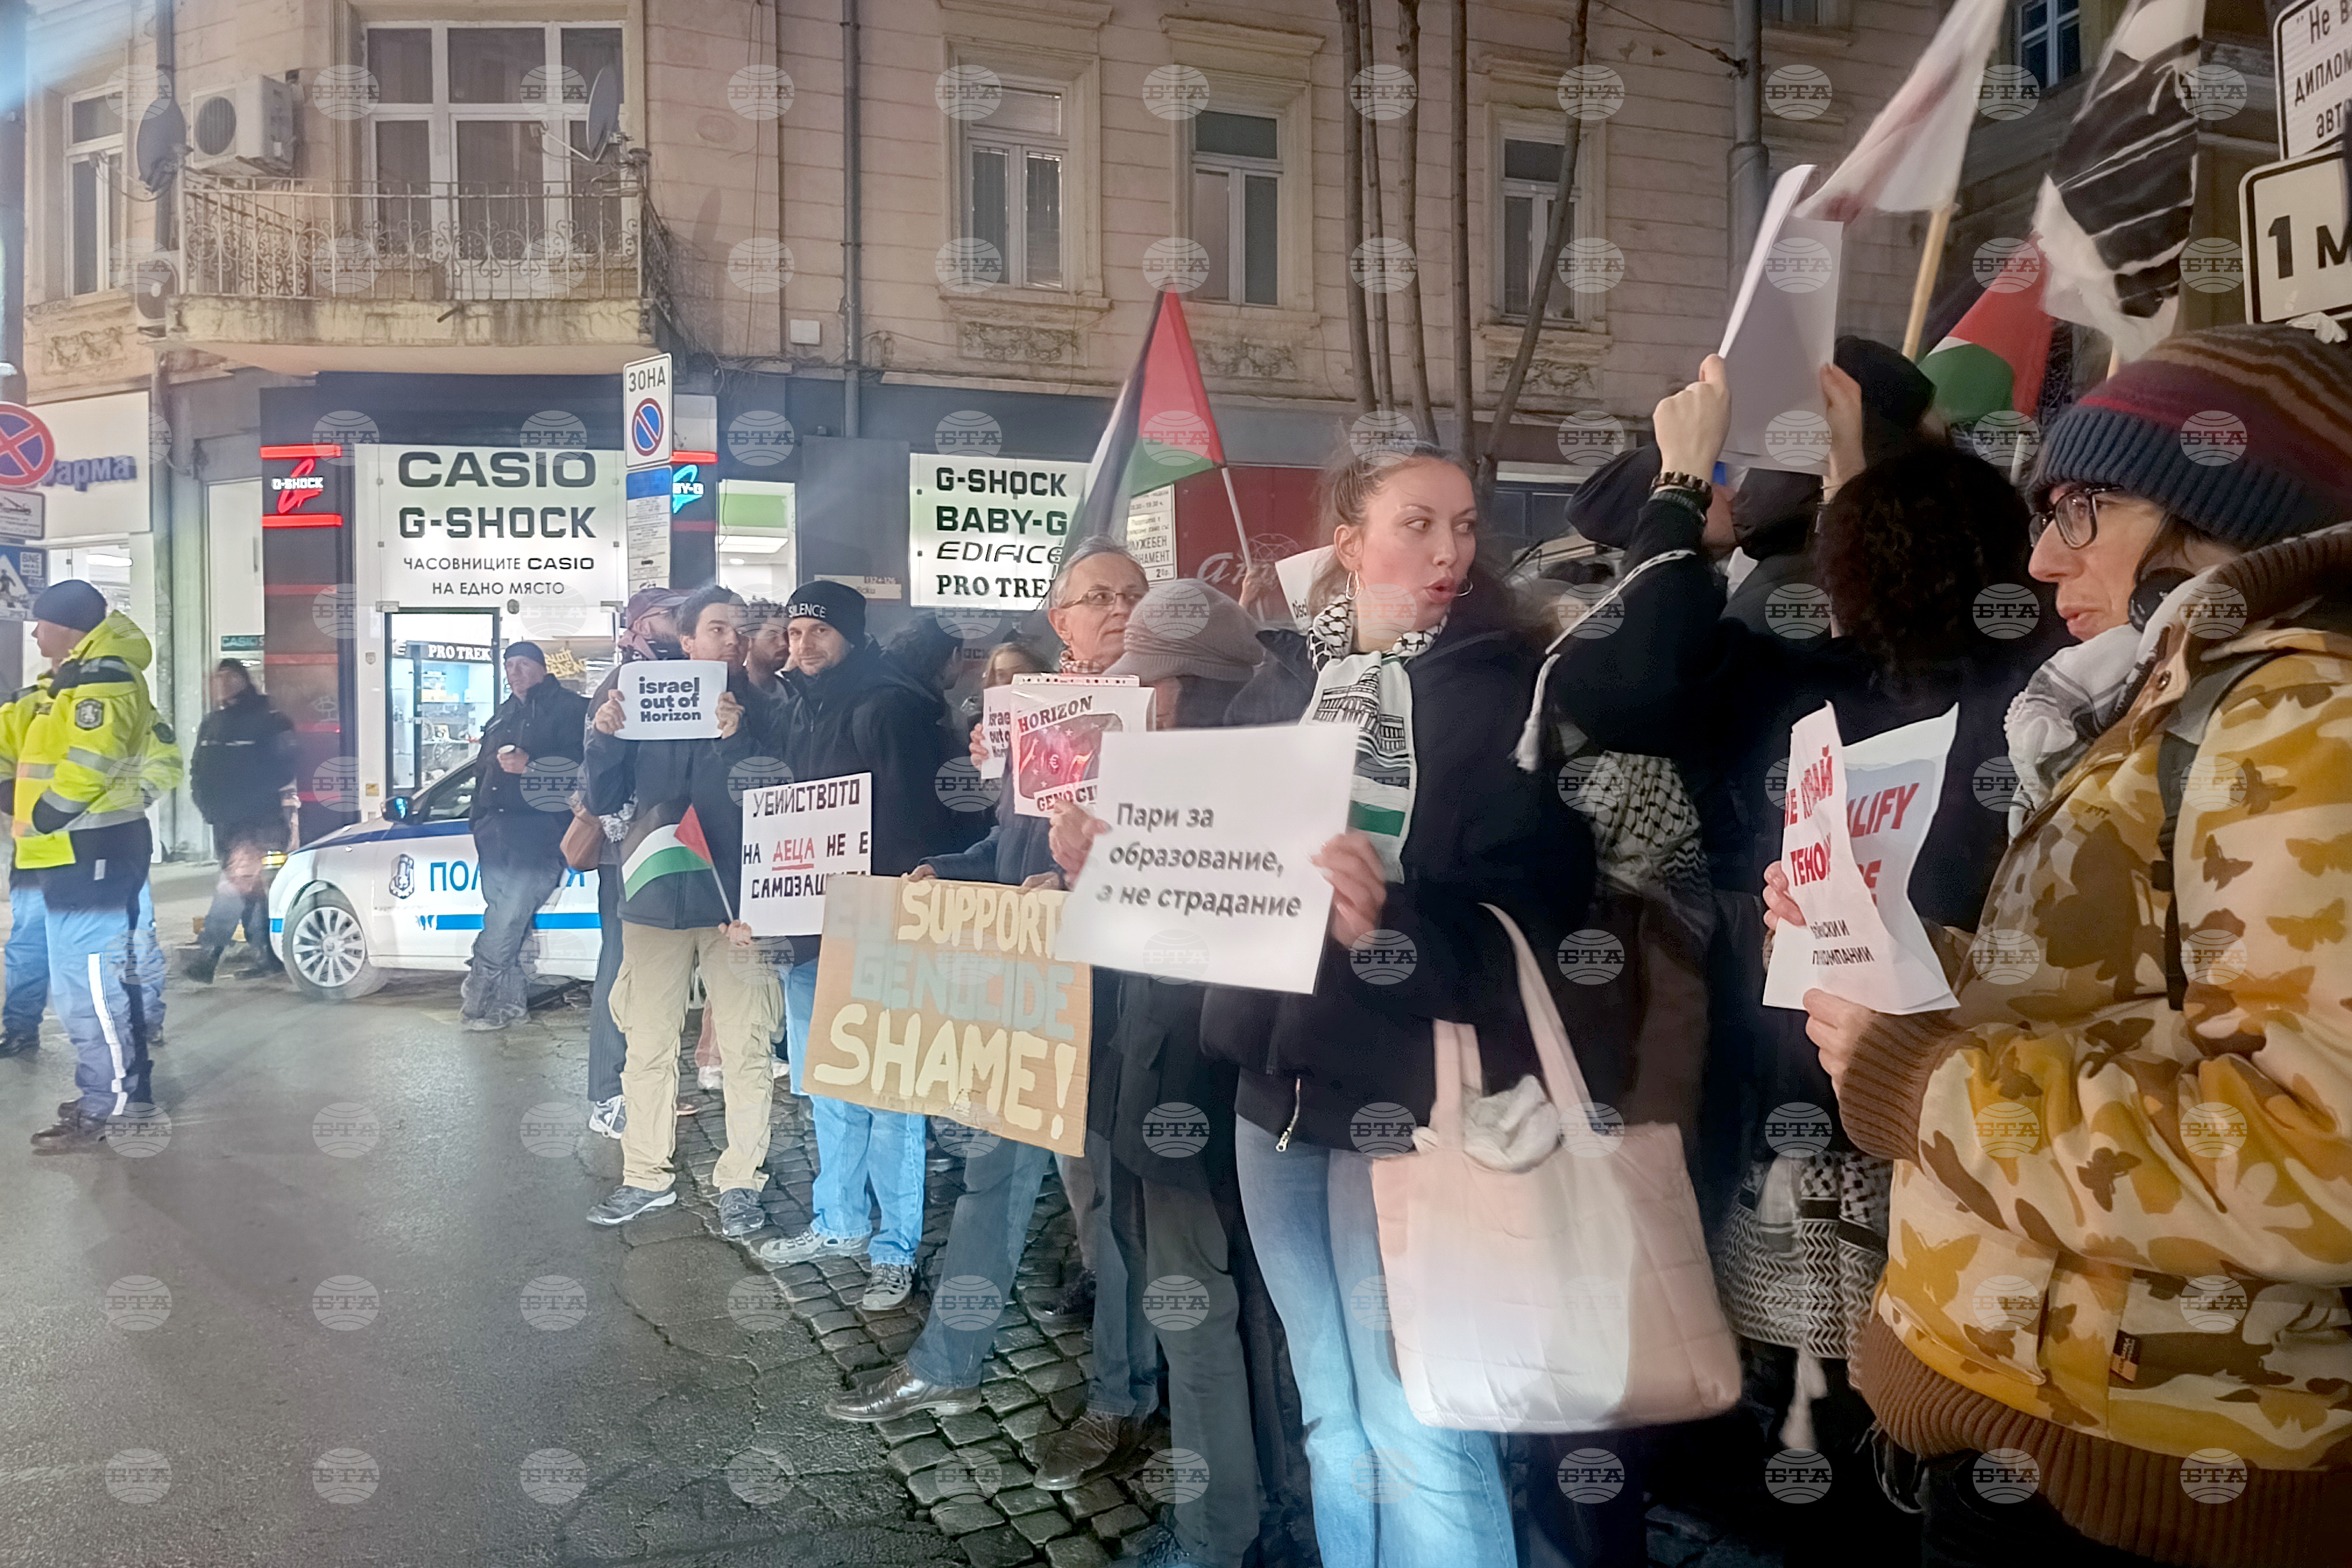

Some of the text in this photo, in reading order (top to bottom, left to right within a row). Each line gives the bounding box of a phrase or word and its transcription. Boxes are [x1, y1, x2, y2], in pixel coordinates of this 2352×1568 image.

[2268, 215, 2294, 280] 1
[628, 366, 666, 393] ЗОНА
[398, 451, 596, 488] CASIO
[936, 467, 1068, 497] G-SHOCK
[399, 507, 597, 538] G-SHOCK
[936, 506, 1068, 536] BABY-G
[403, 558, 594, 571] ЧАСОВНИЦИТЕ CASIO
[432, 582, 564, 595] НА ЕДНО МЯСТО
[936, 575, 1054, 598] PRO TRE
[789, 603, 826, 619] SILENCE
[428, 644, 492, 661] PRO TREK
[639, 676, 700, 694] israel
[640, 692, 699, 709] out of
[640, 708, 702, 722] Horizon
[1018, 695, 1093, 733] HORIZON
[752, 778, 860, 817] УБИЙСТВОТО
[1036, 784, 1097, 812] GENOCI
[1116, 802, 1214, 832] Пари за
[743, 831, 869, 865] НА ДЕЦА НЕ Е
[1109, 842, 1284, 877] образование,
[1120, 885, 1151, 909] не
[1157, 888, 1302, 918] страдание
[850, 940, 1075, 1041] GENOCIDE
[813, 1002, 1077, 1140] SHAME!
